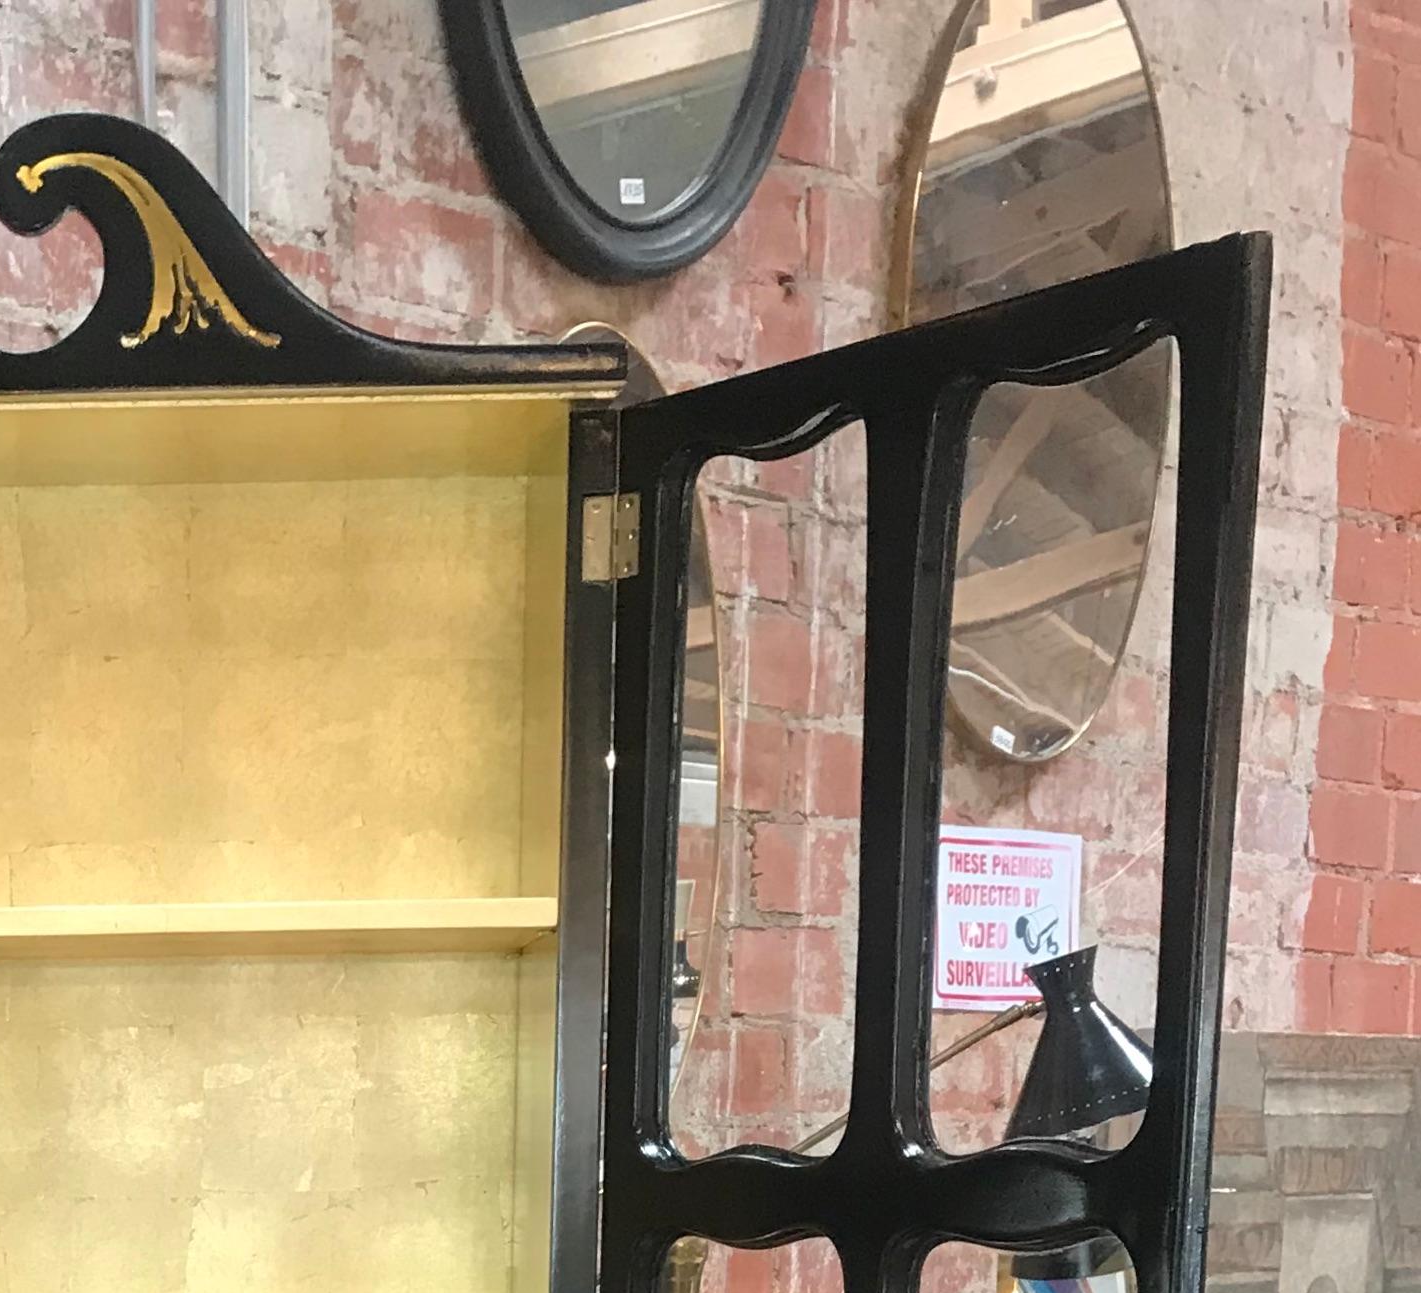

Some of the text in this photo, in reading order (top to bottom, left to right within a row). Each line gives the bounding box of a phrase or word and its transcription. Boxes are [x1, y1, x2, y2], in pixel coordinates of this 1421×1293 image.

[948, 851, 1054, 879] THESE PREMISES
[946, 883, 1040, 908] PROTECTED BY
[946, 959, 1036, 988] SURVEILLA
